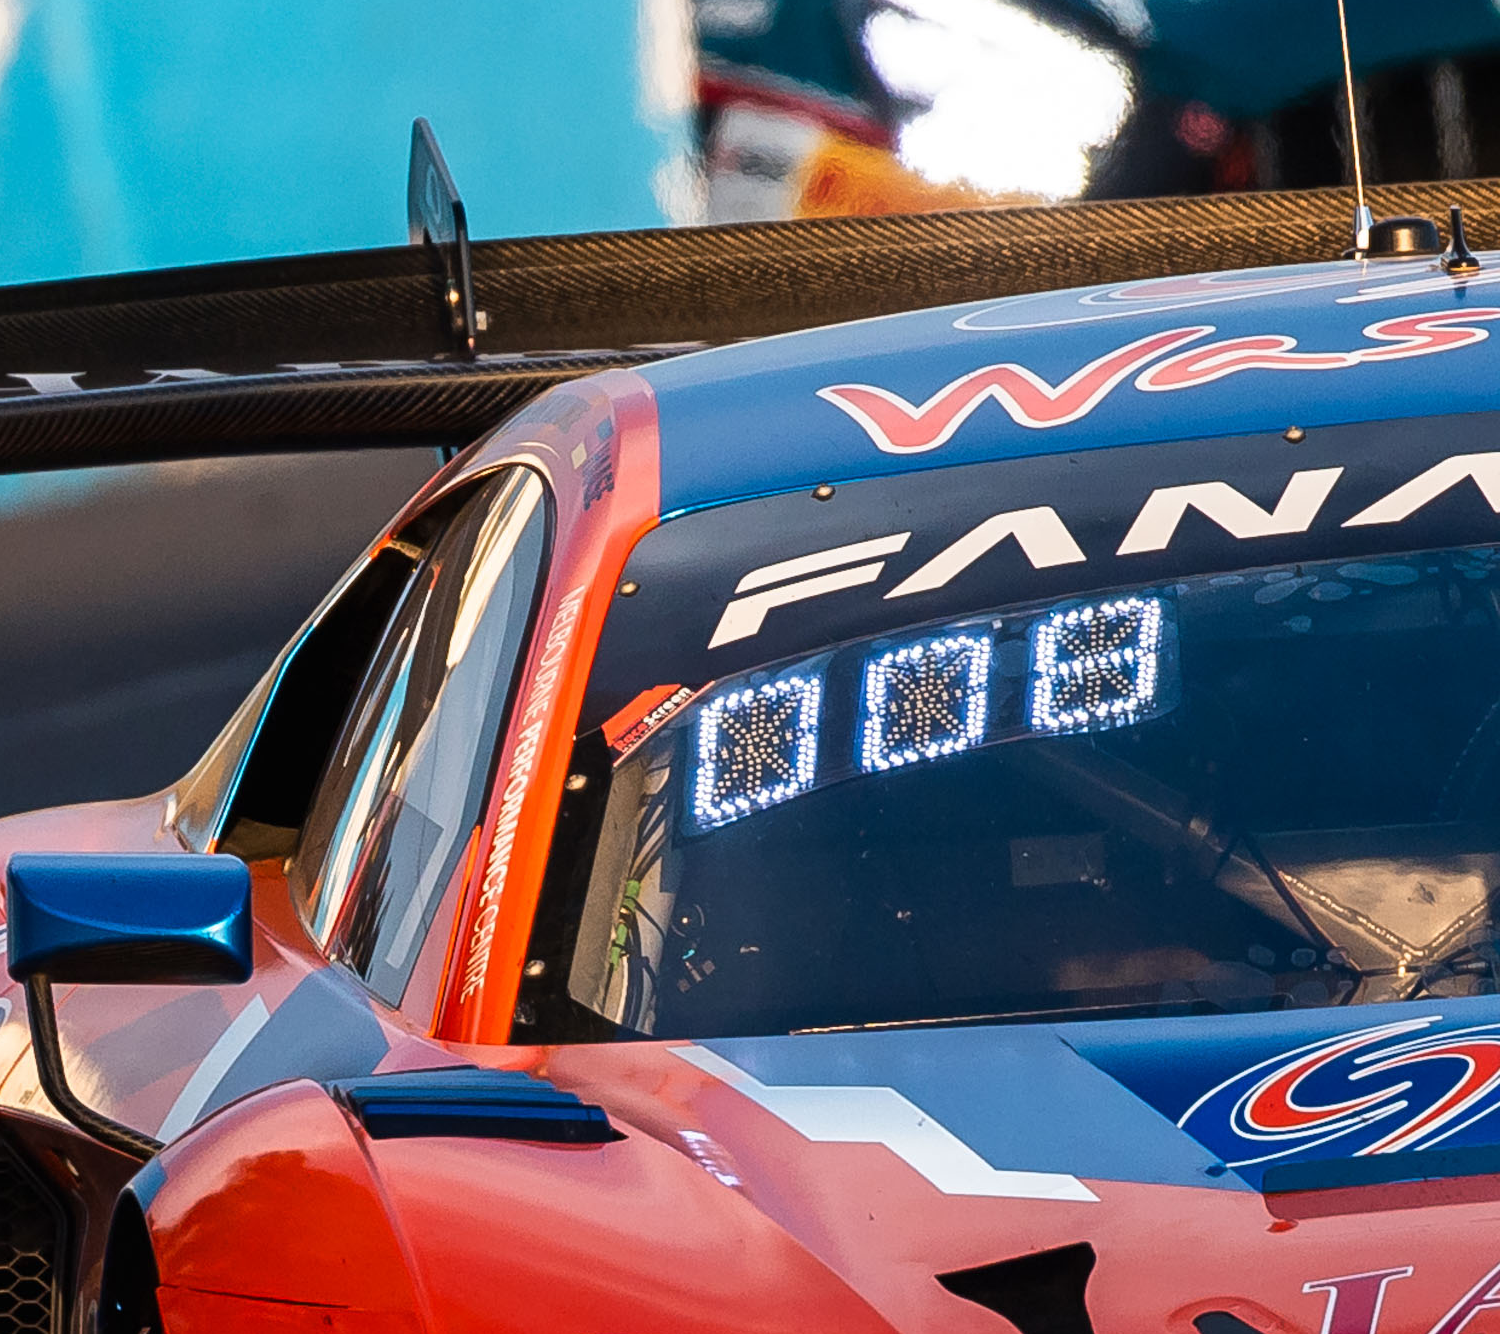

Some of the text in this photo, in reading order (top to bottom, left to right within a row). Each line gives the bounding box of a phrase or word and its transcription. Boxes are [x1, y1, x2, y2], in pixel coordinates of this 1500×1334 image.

[460, 584, 586, 1004] MELBOURNE PERFORMANCE CENTRE
